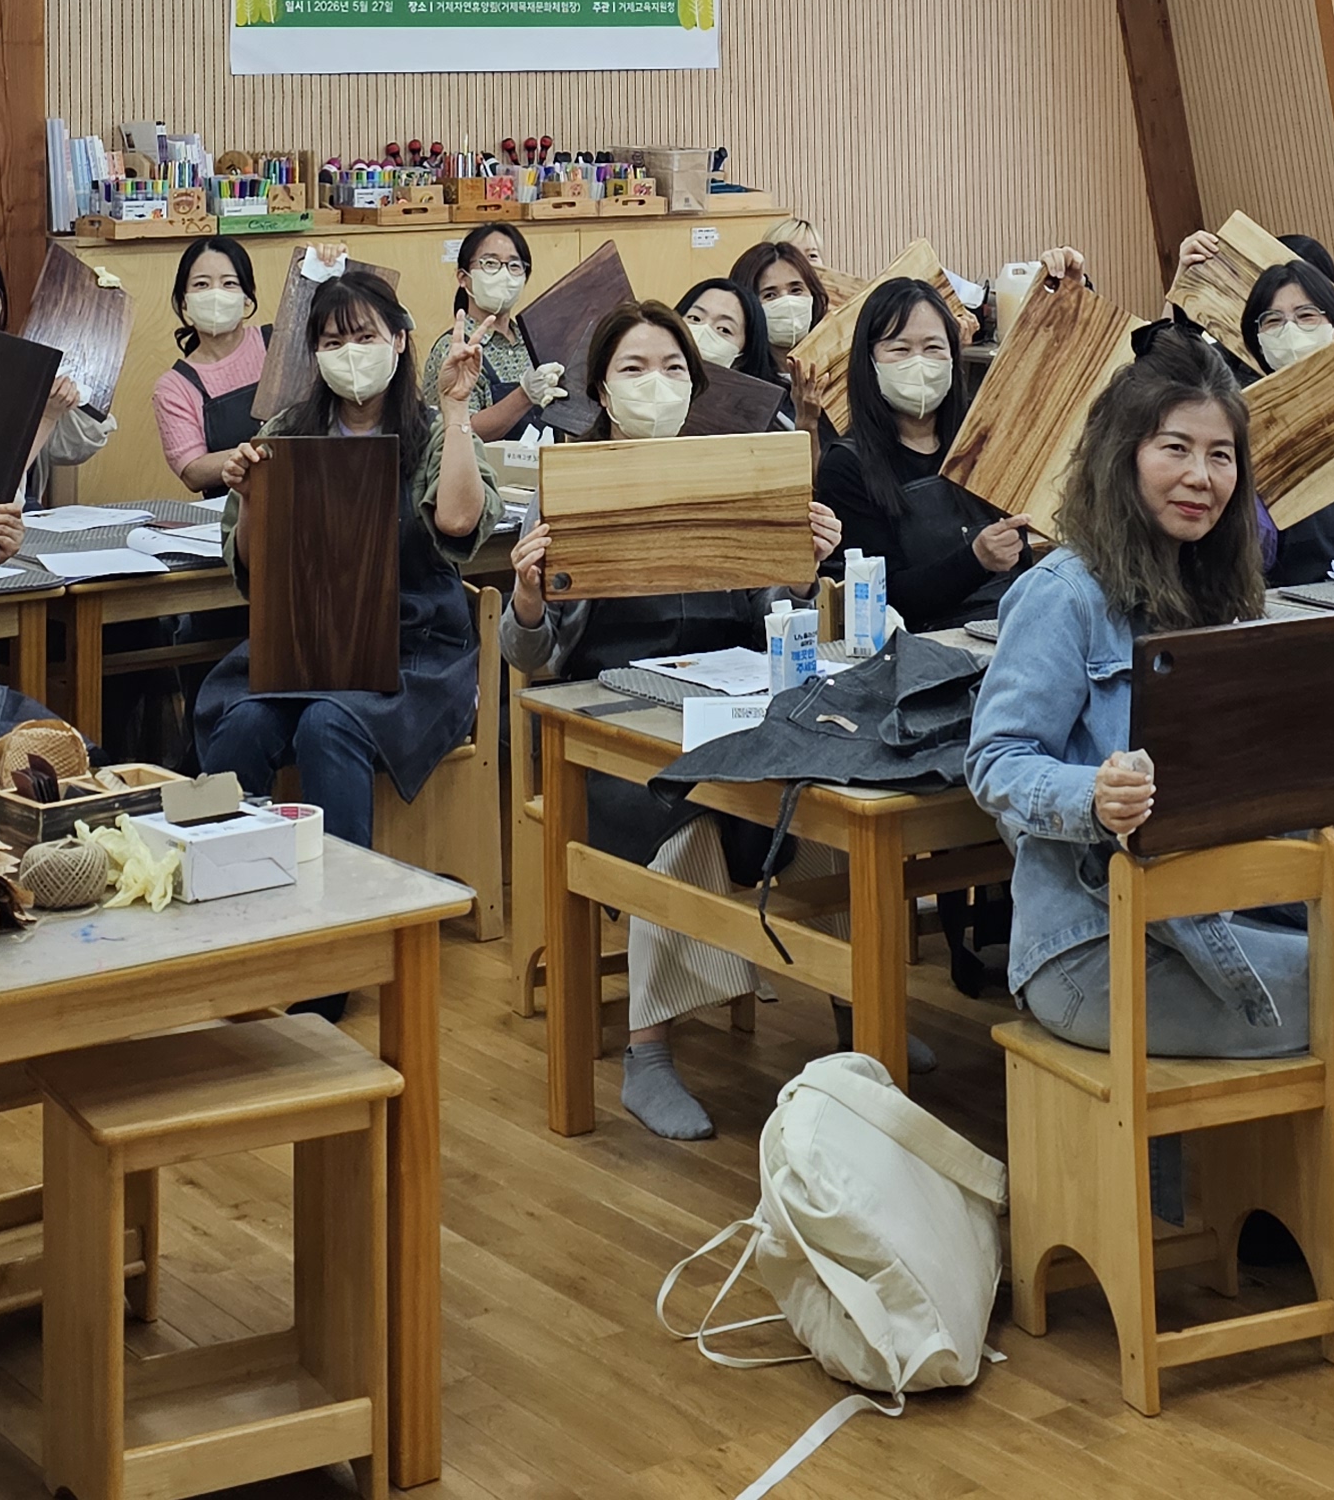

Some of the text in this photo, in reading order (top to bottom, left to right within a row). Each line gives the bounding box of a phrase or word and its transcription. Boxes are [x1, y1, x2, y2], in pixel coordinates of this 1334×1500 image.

[285, 0, 304, 13] 일시
[314, 1, 349, 13] 2026년
[352, 1, 368, 13] 5월
[372, 1, 393, 13] 27일
[408, 1, 428, 13] 장소
[592, 2, 610, 13] 주관
[618, 2, 675, 13] 거제교육지원청
